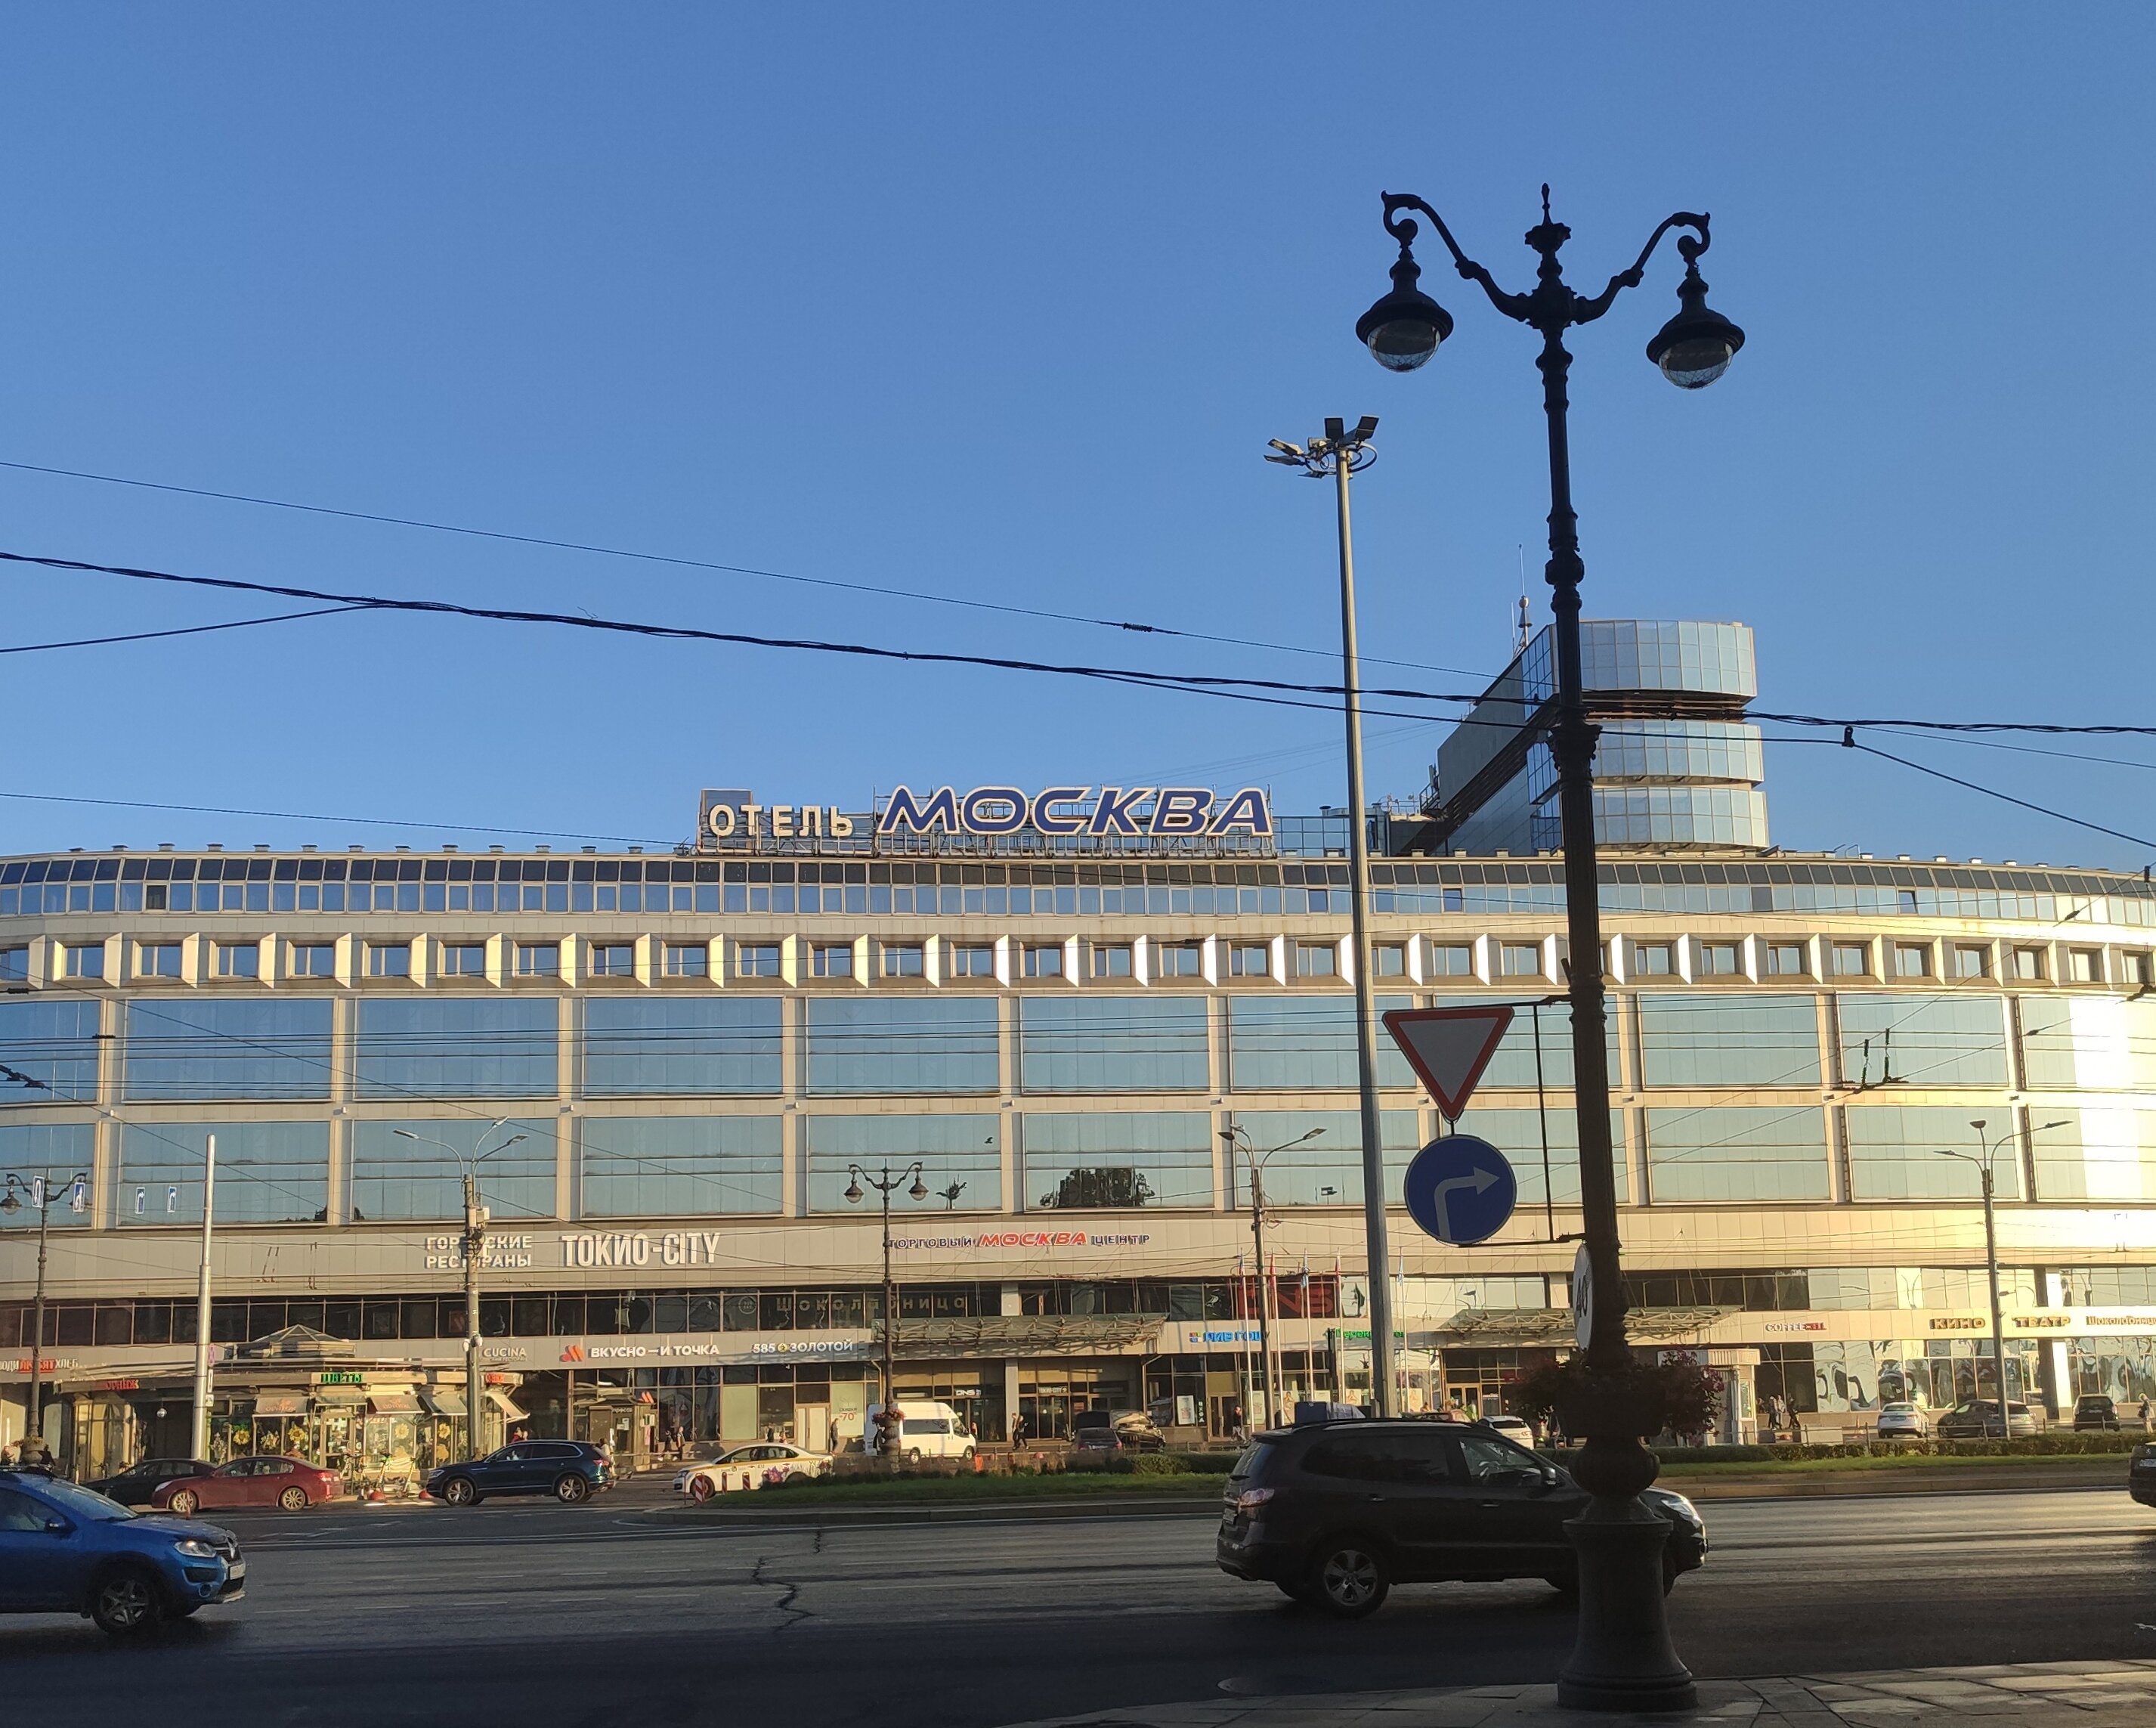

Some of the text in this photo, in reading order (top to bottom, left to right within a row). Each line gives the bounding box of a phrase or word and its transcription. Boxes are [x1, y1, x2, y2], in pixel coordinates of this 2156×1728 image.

[709, 785, 1274, 838] ОТЕЛЬ МОСКВА
[426, 1236, 532, 1250] ГОРСКИЕ
[889, 1231, 1150, 1248] ТОРГОВЫЙ МОСКВА ЦЕНТР
[1576, 1274, 1588, 1318] 40
[1931, 1316, 2071, 1329] КИНО ТЕАТР
[2086, 1315, 2156, 1326] Шоколадниц
[484, 1348, 527, 1358] CUCINA
[590, 1346, 646, 1358] ВКУСНО
[673, 1344, 720, 1356] ТОЧКА
[753, 1338, 853, 1354] 585 ЗОЛОТОЙ
